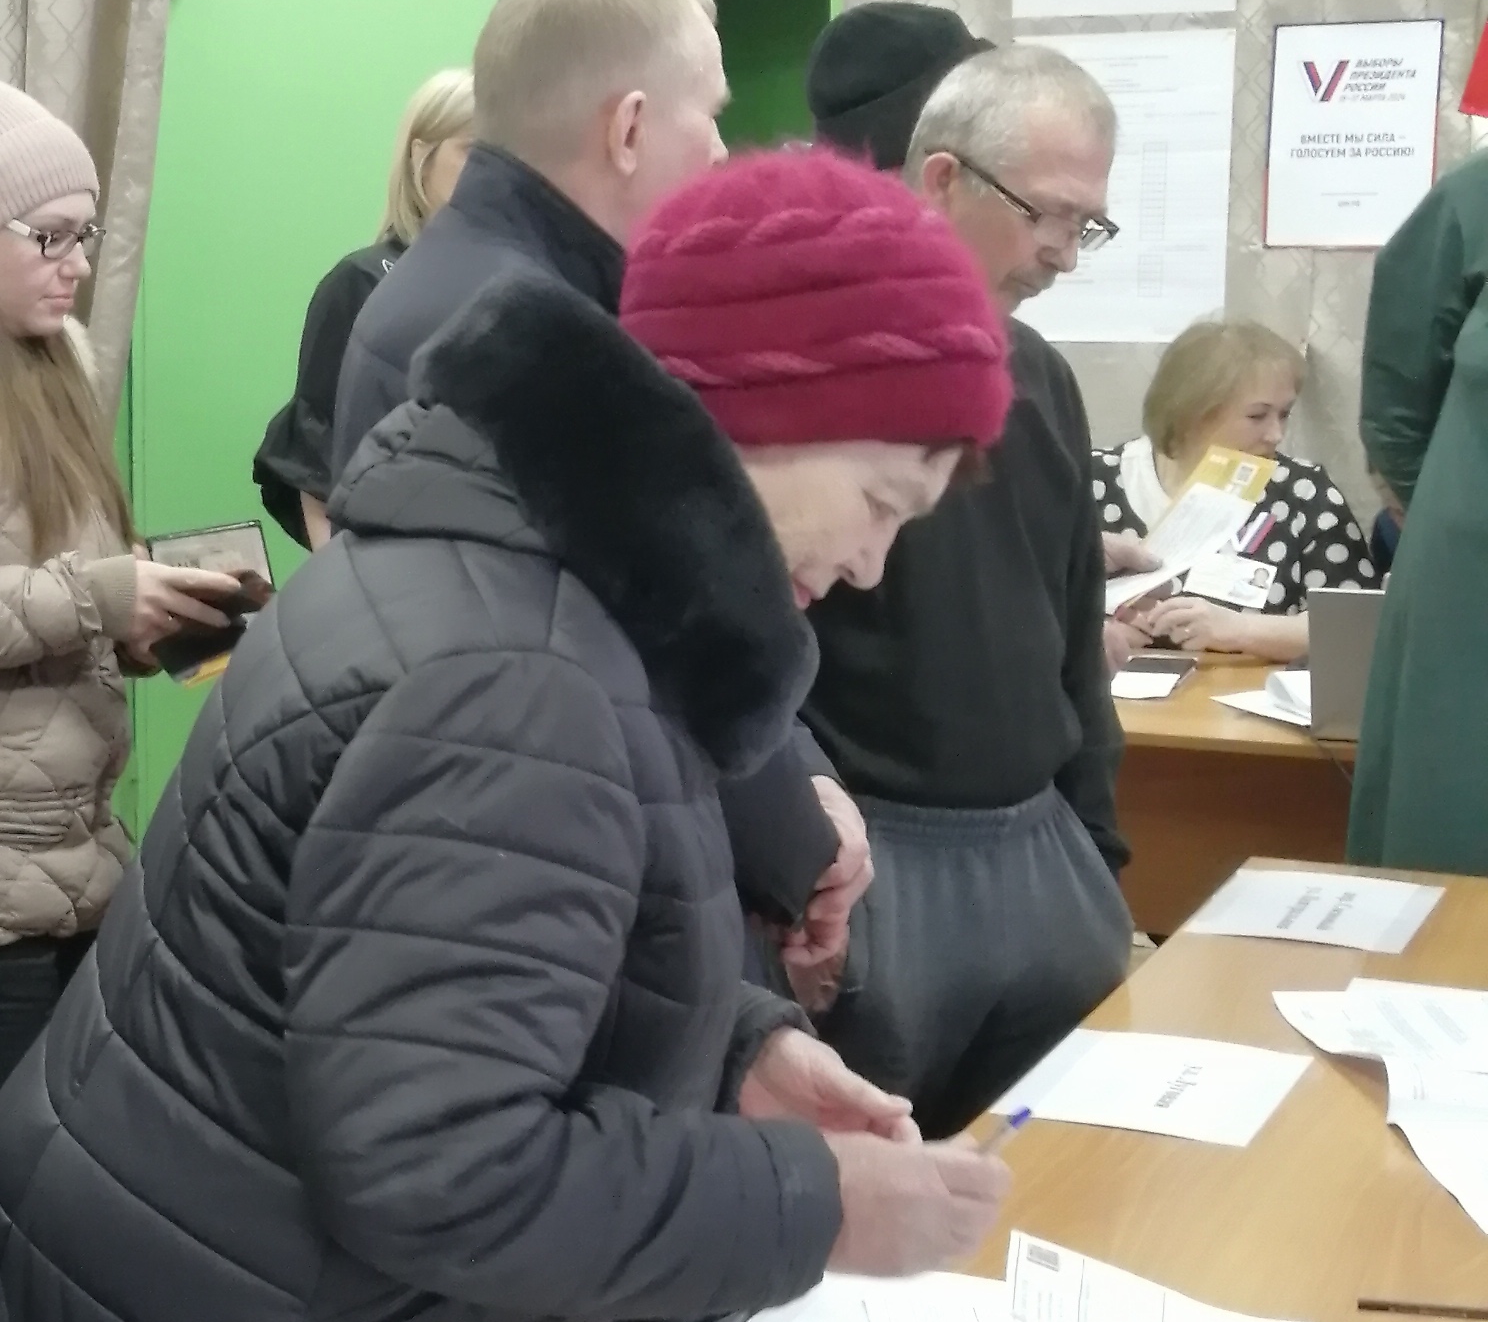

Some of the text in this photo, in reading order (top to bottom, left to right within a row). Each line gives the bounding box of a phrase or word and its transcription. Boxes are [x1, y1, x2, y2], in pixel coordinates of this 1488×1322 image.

[1300, 133, 1341, 144] ВМЕСТЕ
[1344, 133, 1363, 144] МЫ
[1290, 147, 1346, 158] ГОЛОСУЕМ
